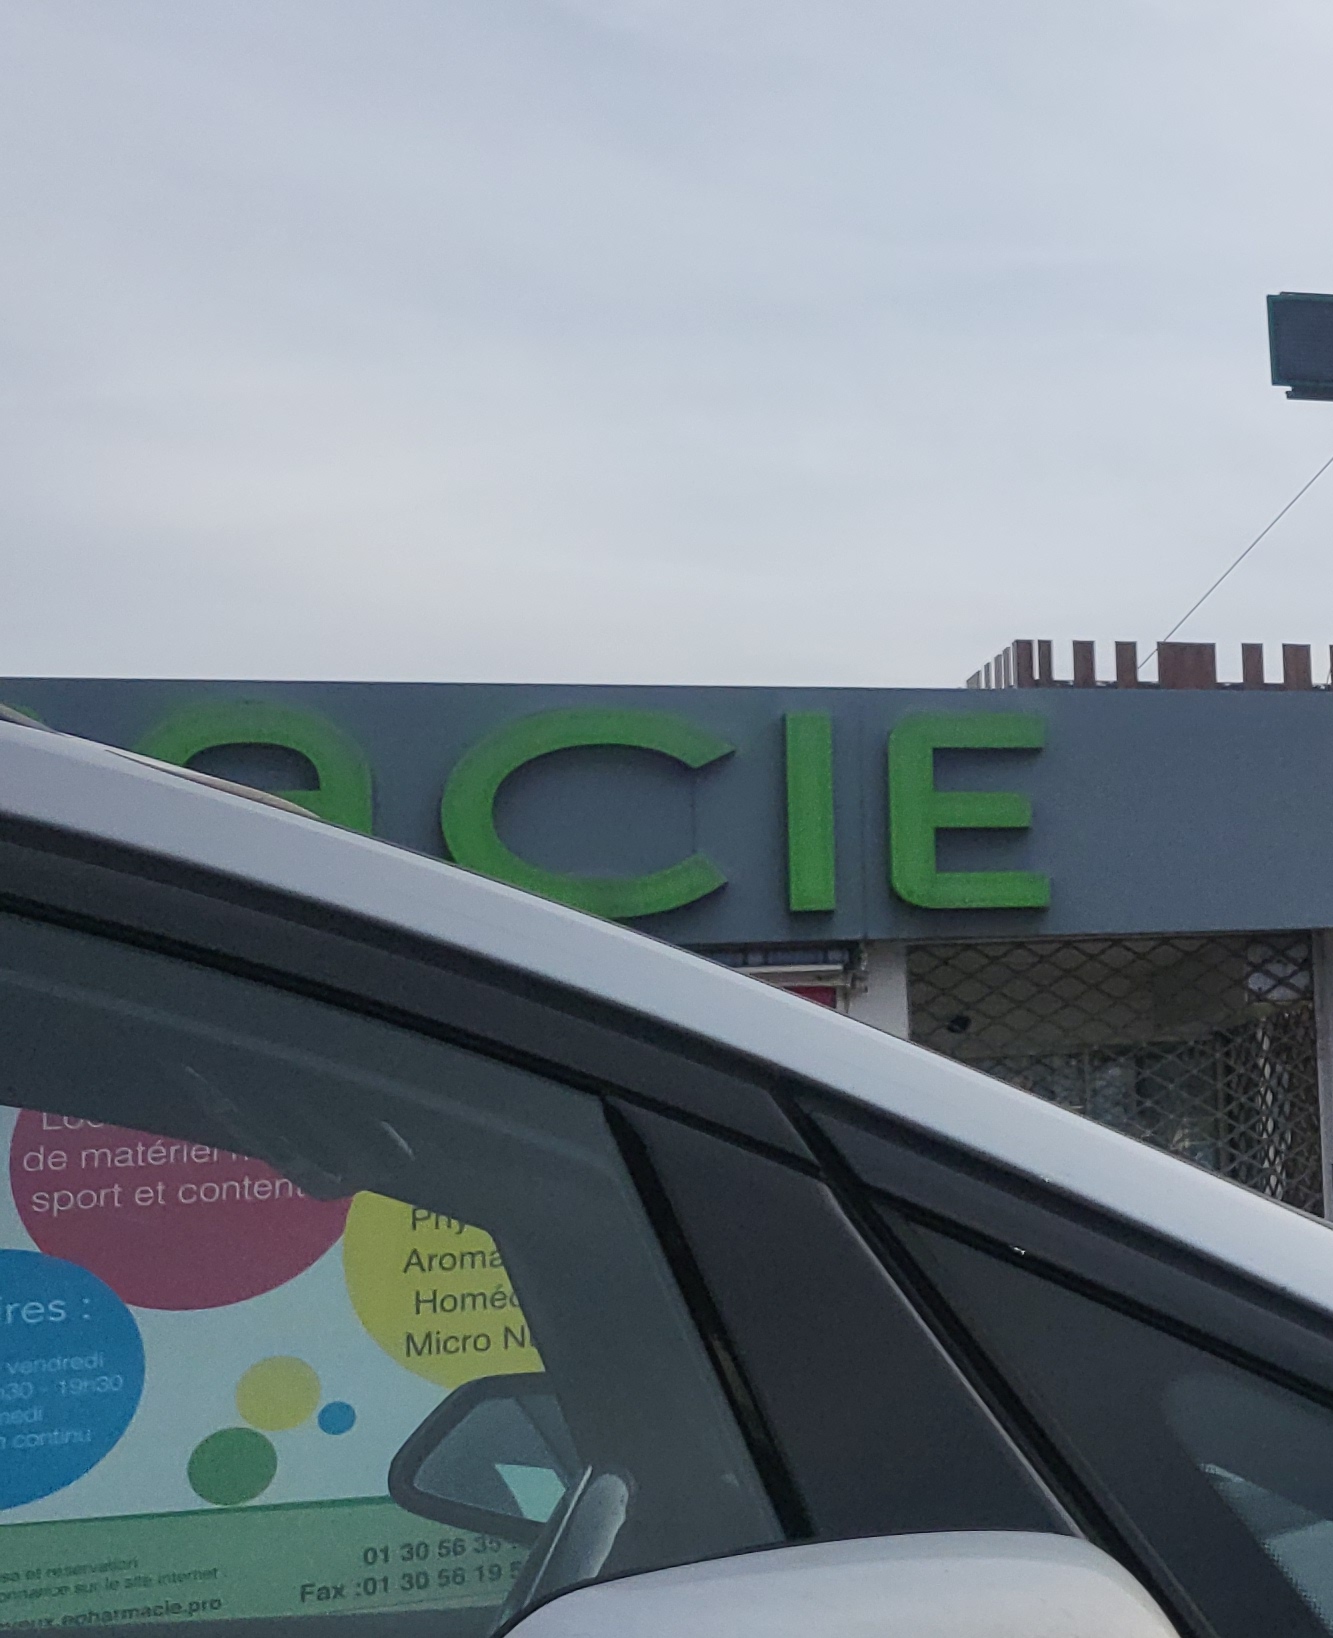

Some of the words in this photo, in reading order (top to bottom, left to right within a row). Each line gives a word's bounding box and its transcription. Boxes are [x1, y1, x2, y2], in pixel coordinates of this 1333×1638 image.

[22, 1145, 68, 1173] de
[31, 1182, 123, 1218] sport
[134, 1180, 166, 1207] et
[403, 1248, 505, 1274] Aroma
[405, 1330, 492, 1358] Micro
[7, 1352, 104, 1375] vendredi
[58, 1374, 123, 1395] 19h30
[363, 1545, 391, 1565] 01
[400, 1541, 430, 1562] 30
[437, 1537, 467, 1558] 56
[300, 1583, 346, 1603] Fax
[400, 1571, 431, 1592] 30
[475, 1563, 503, 1583] 19
